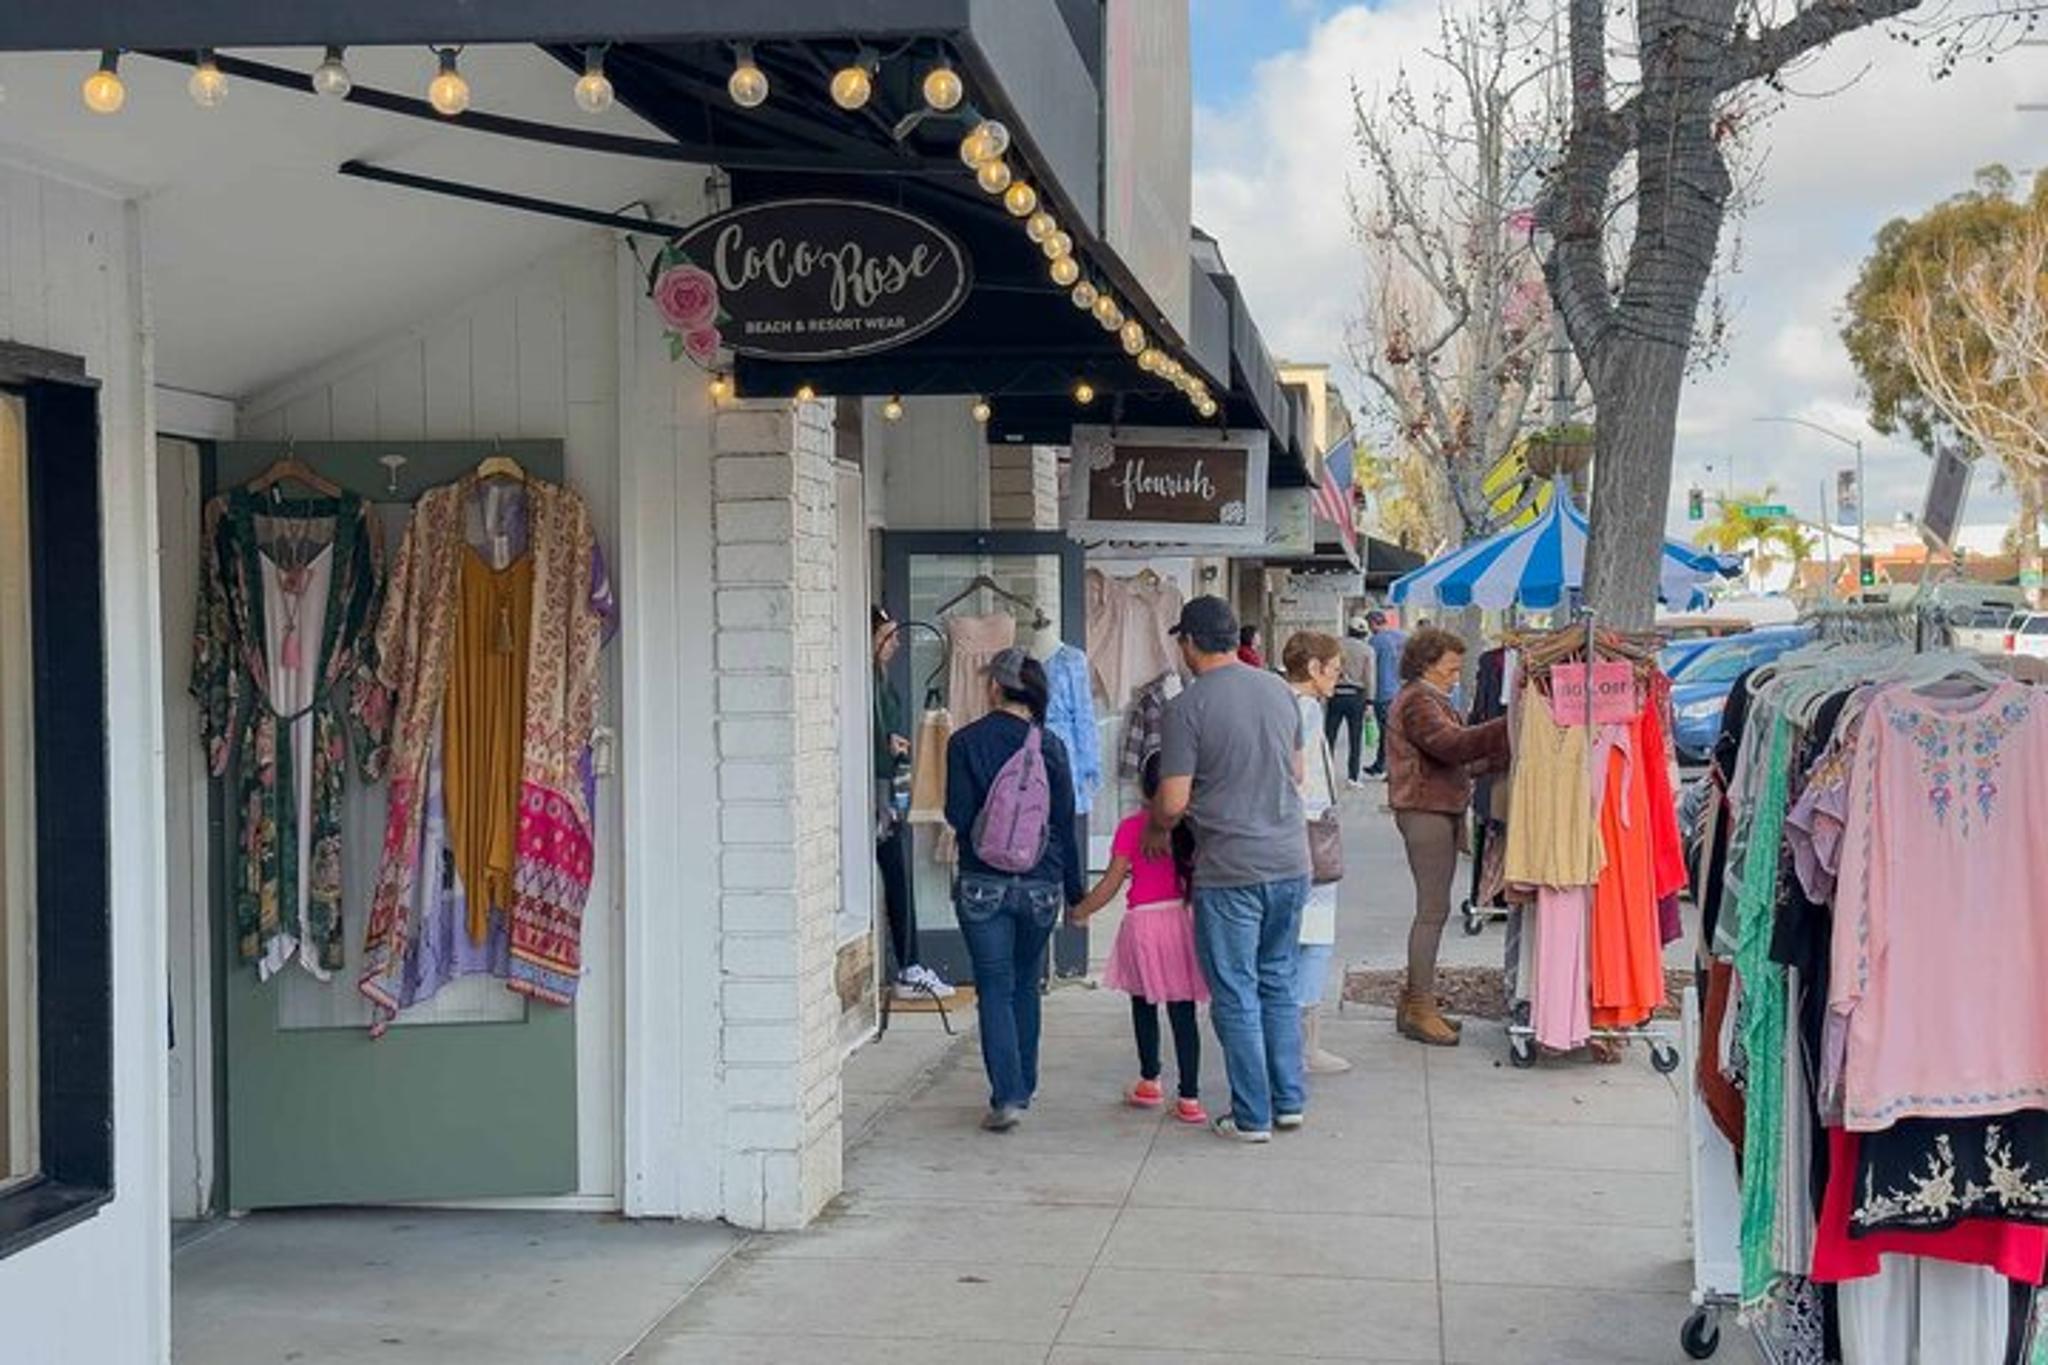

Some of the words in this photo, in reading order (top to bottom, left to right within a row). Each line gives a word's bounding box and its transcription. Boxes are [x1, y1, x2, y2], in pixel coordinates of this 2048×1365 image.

[818, 241, 942, 313] Rose
[745, 321, 792, 335] BEACH
[795, 320, 806, 334] &
[809, 318, 861, 333] RESORT
[865, 315, 906, 331] WEAR
[1111, 458, 1216, 511] flourish
